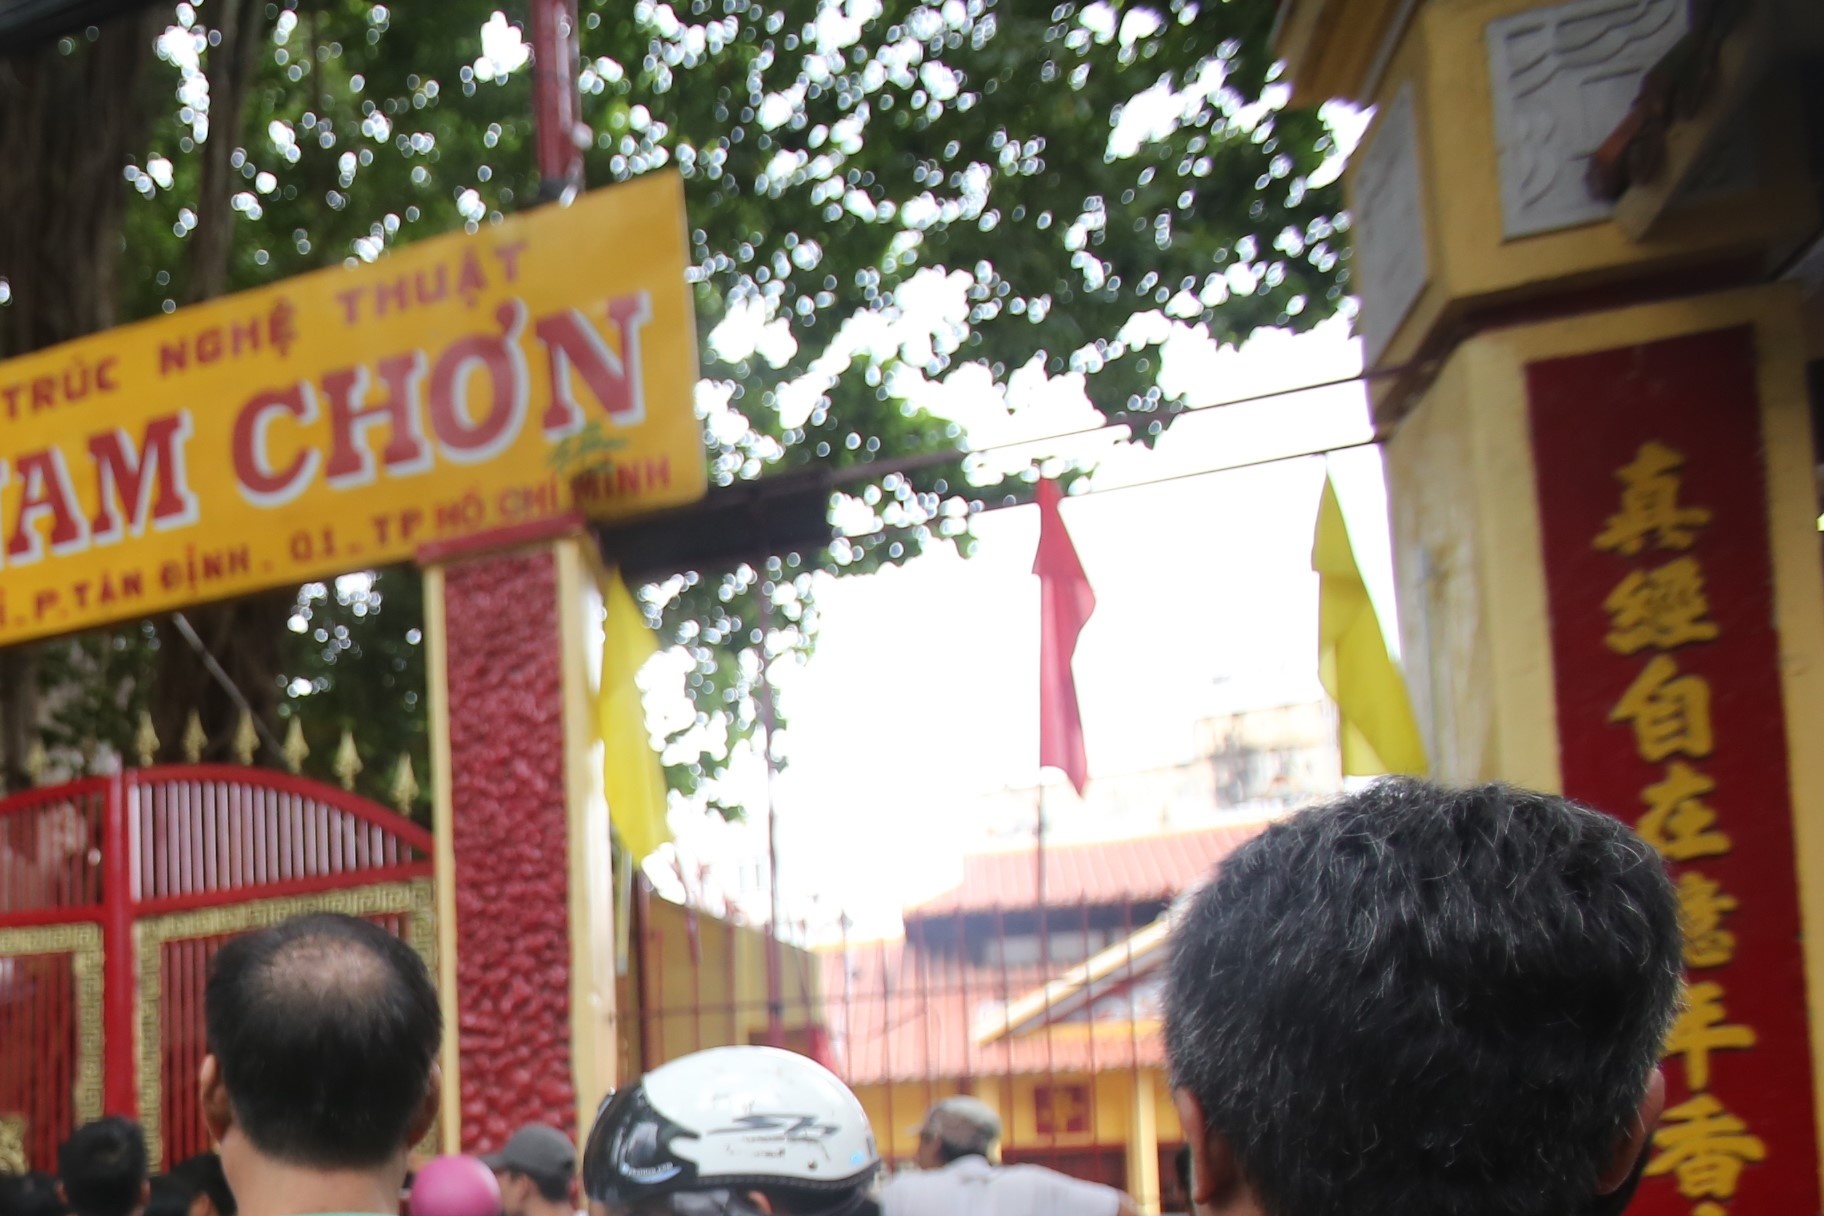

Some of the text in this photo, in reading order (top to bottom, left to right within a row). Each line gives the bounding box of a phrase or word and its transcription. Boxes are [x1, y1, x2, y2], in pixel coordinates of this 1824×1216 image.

[157, 296, 295, 378] NGHỆ
[336, 242, 528, 326] THUẬT
[230, 289, 653, 508] CHƠN
[570, 454, 672, 504] MINH
